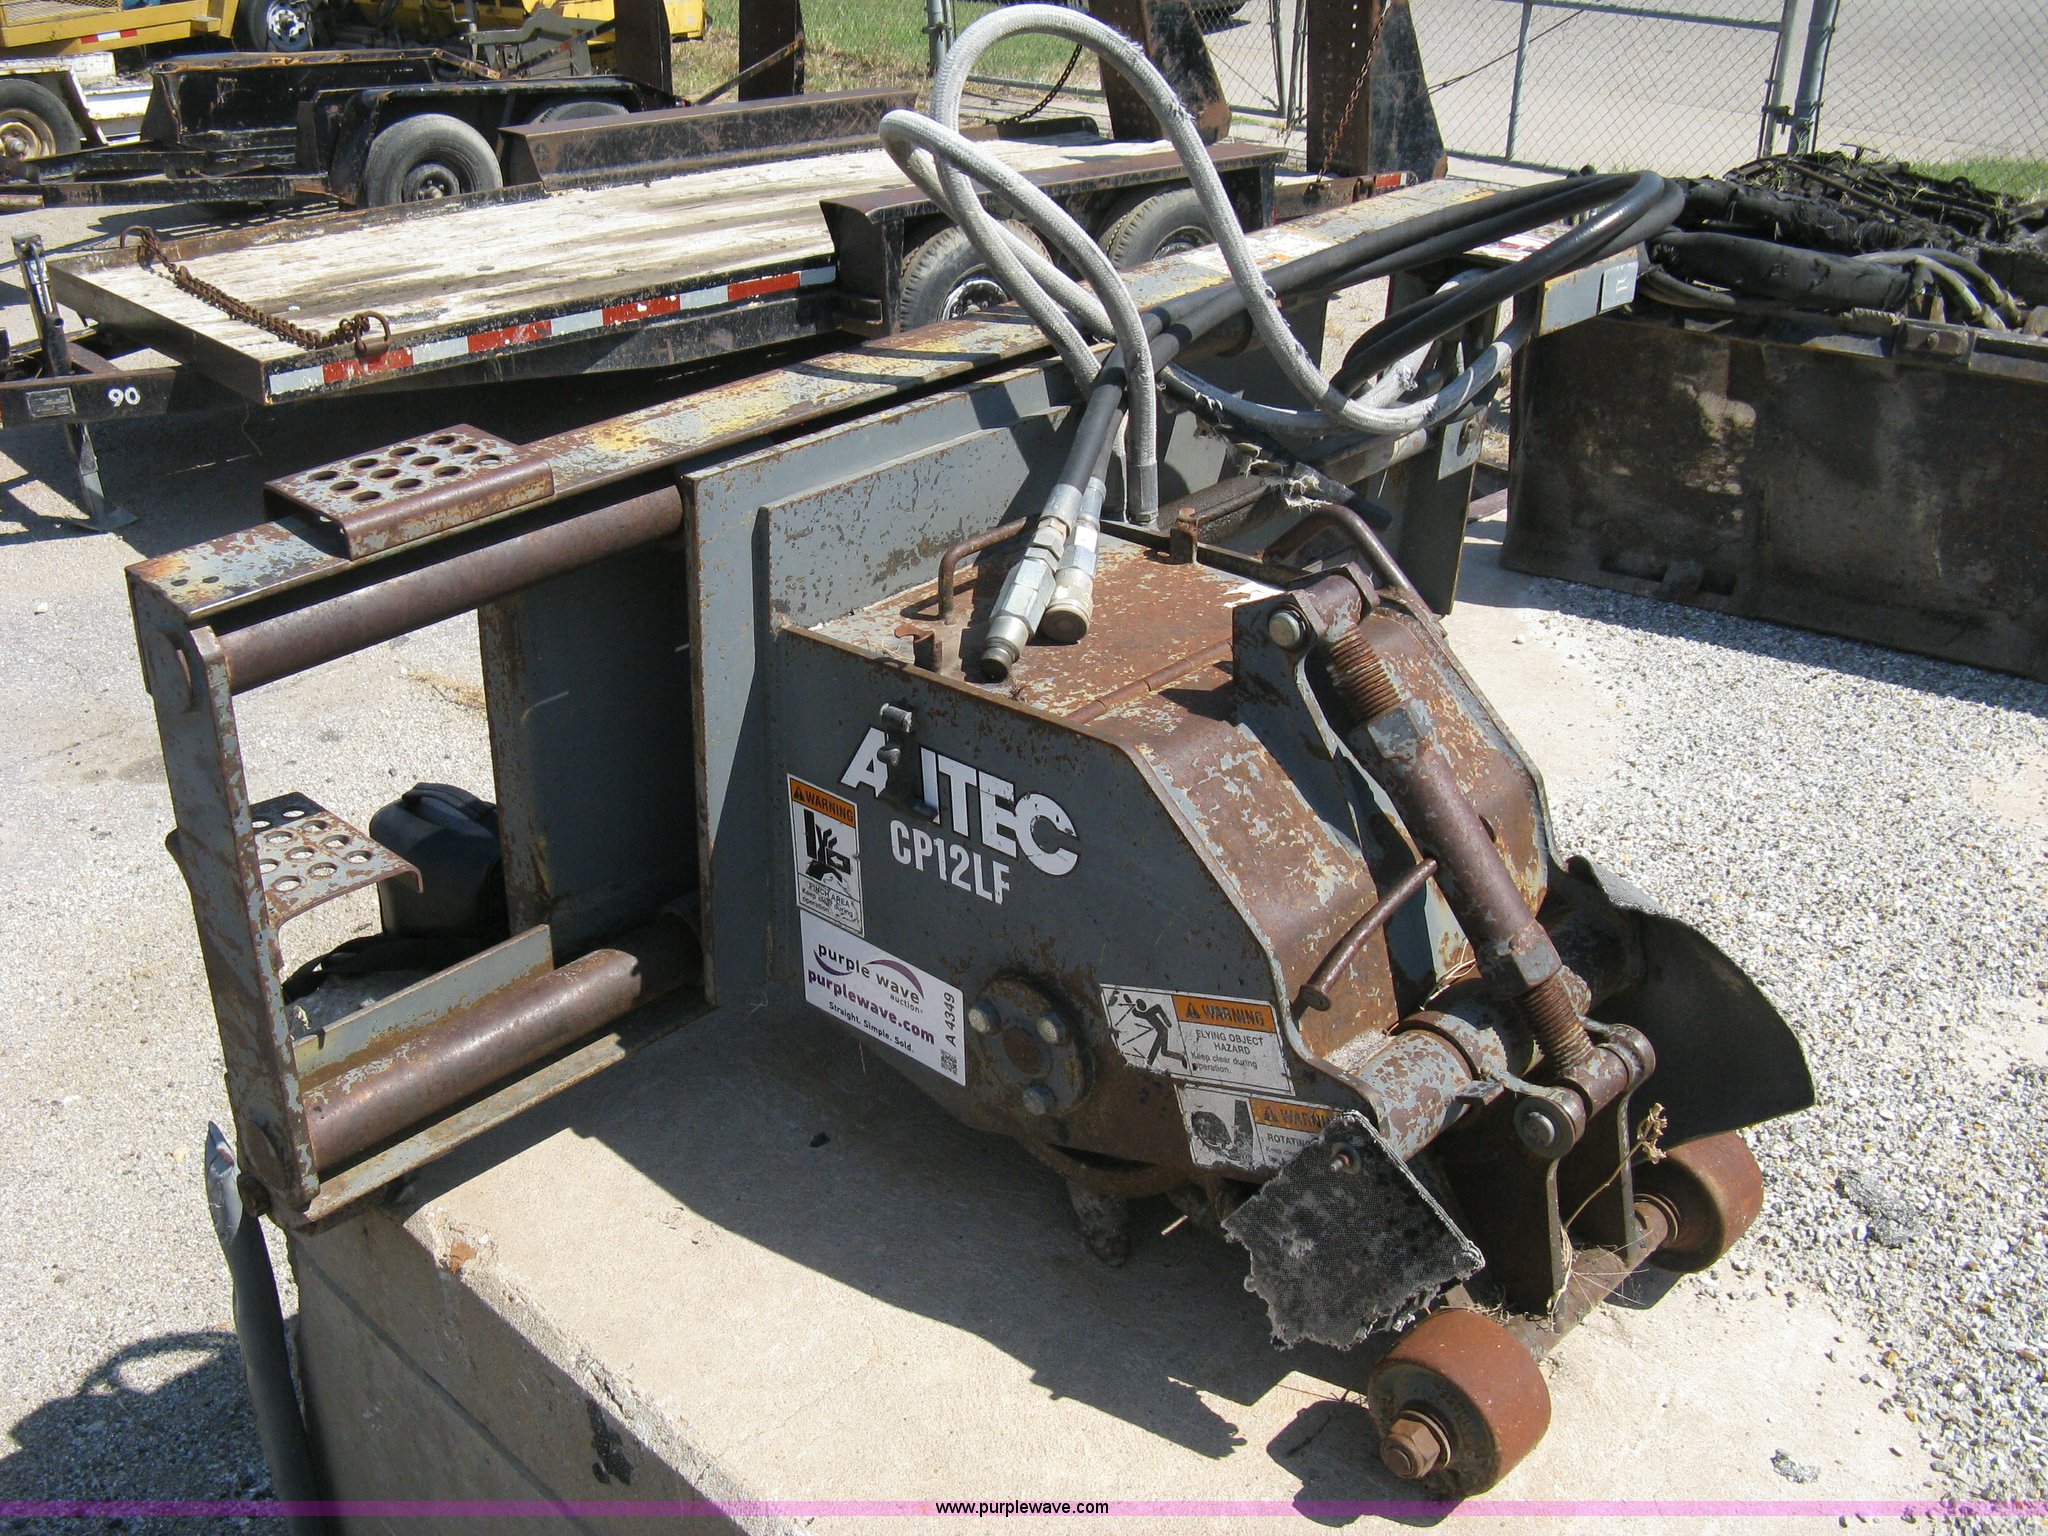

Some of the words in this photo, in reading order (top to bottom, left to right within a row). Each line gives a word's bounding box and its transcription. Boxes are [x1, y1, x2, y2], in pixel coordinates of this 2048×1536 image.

[108, 387, 141, 407] 90
[805, 790, 854, 822] WARNING
[840, 727, 1079, 876] AITEC
[889, 819, 1011, 905] CP12LF
[830, 892, 851, 908] AREA
[818, 943, 870, 979] purple
[876, 972, 920, 1005] wave
[808, 969, 936, 1046] purplewave.com
[944, 992, 957, 1031] 4349
[1202, 1003, 1265, 1027] WARNING
[828, 1001, 862, 1025] Straight.
[863, 1020, 893, 1042] Simple.
[894, 1035, 915, 1053] Sold.
[945, 1035, 957, 1047] A
[1195, 1029, 1227, 1043] FLYING
[1228, 1032, 1265, 1047] OBJECT
[1190, 1051, 1210, 1065] Keep
[1211, 1053, 1231, 1065] clear
[1232, 1056, 1258, 1071] during
[1213, 1042, 1251, 1055] HAZARD
